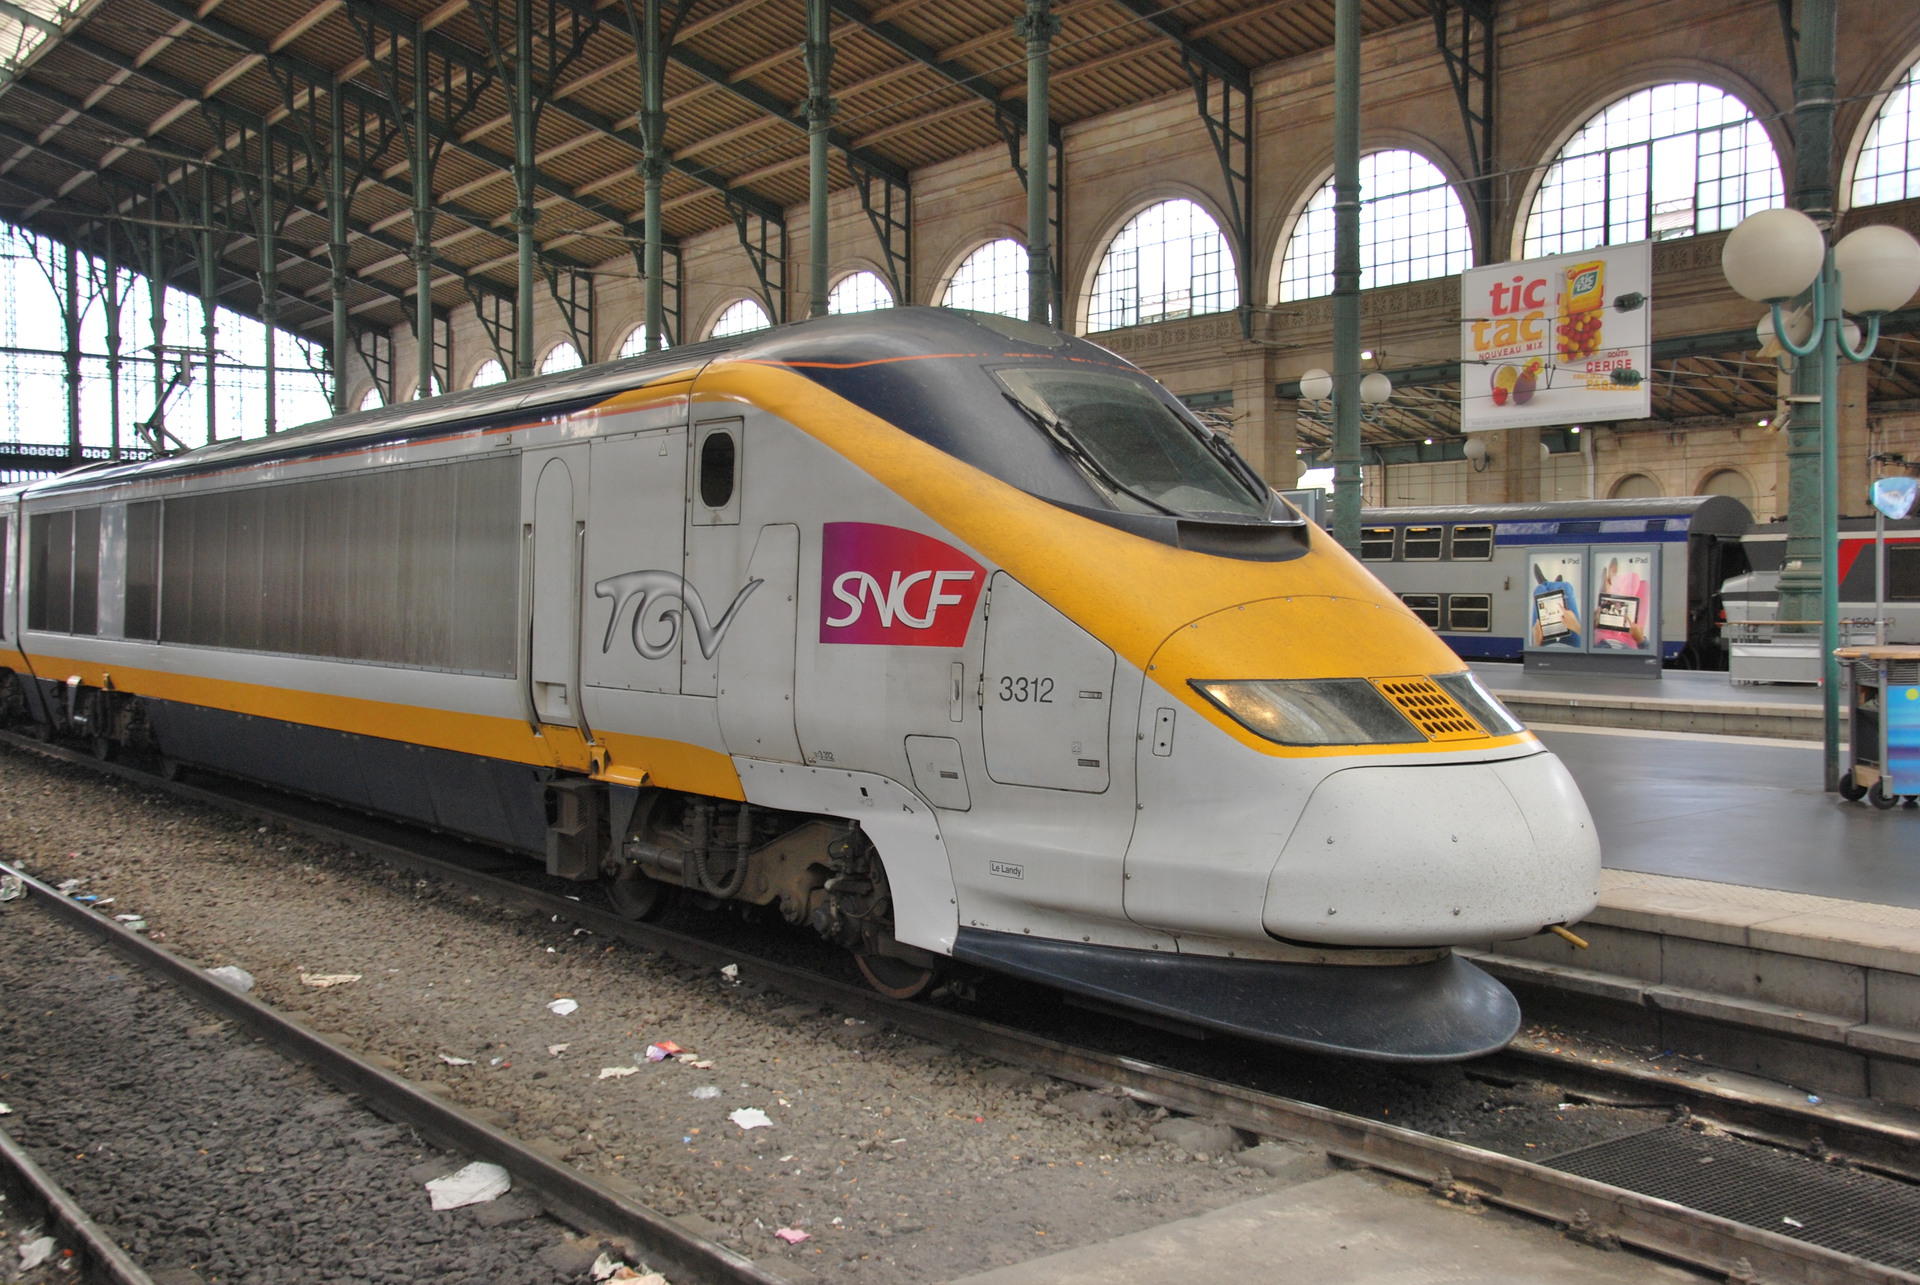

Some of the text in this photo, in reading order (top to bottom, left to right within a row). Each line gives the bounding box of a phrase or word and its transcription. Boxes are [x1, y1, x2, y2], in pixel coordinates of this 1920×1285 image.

[1489, 276, 1547, 316] tic
[1577, 282, 1593, 292] tac
[1471, 311, 1545, 351] tac
[1479, 341, 1544, 360] NOUVEAU MIX
[1586, 359, 1632, 372] CERISE
[825, 569, 975, 629] SNCF
[595, 569, 764, 660] TGV
[999, 676, 1054, 703] 3312
[991, 863, 1022, 877] Le Landy
